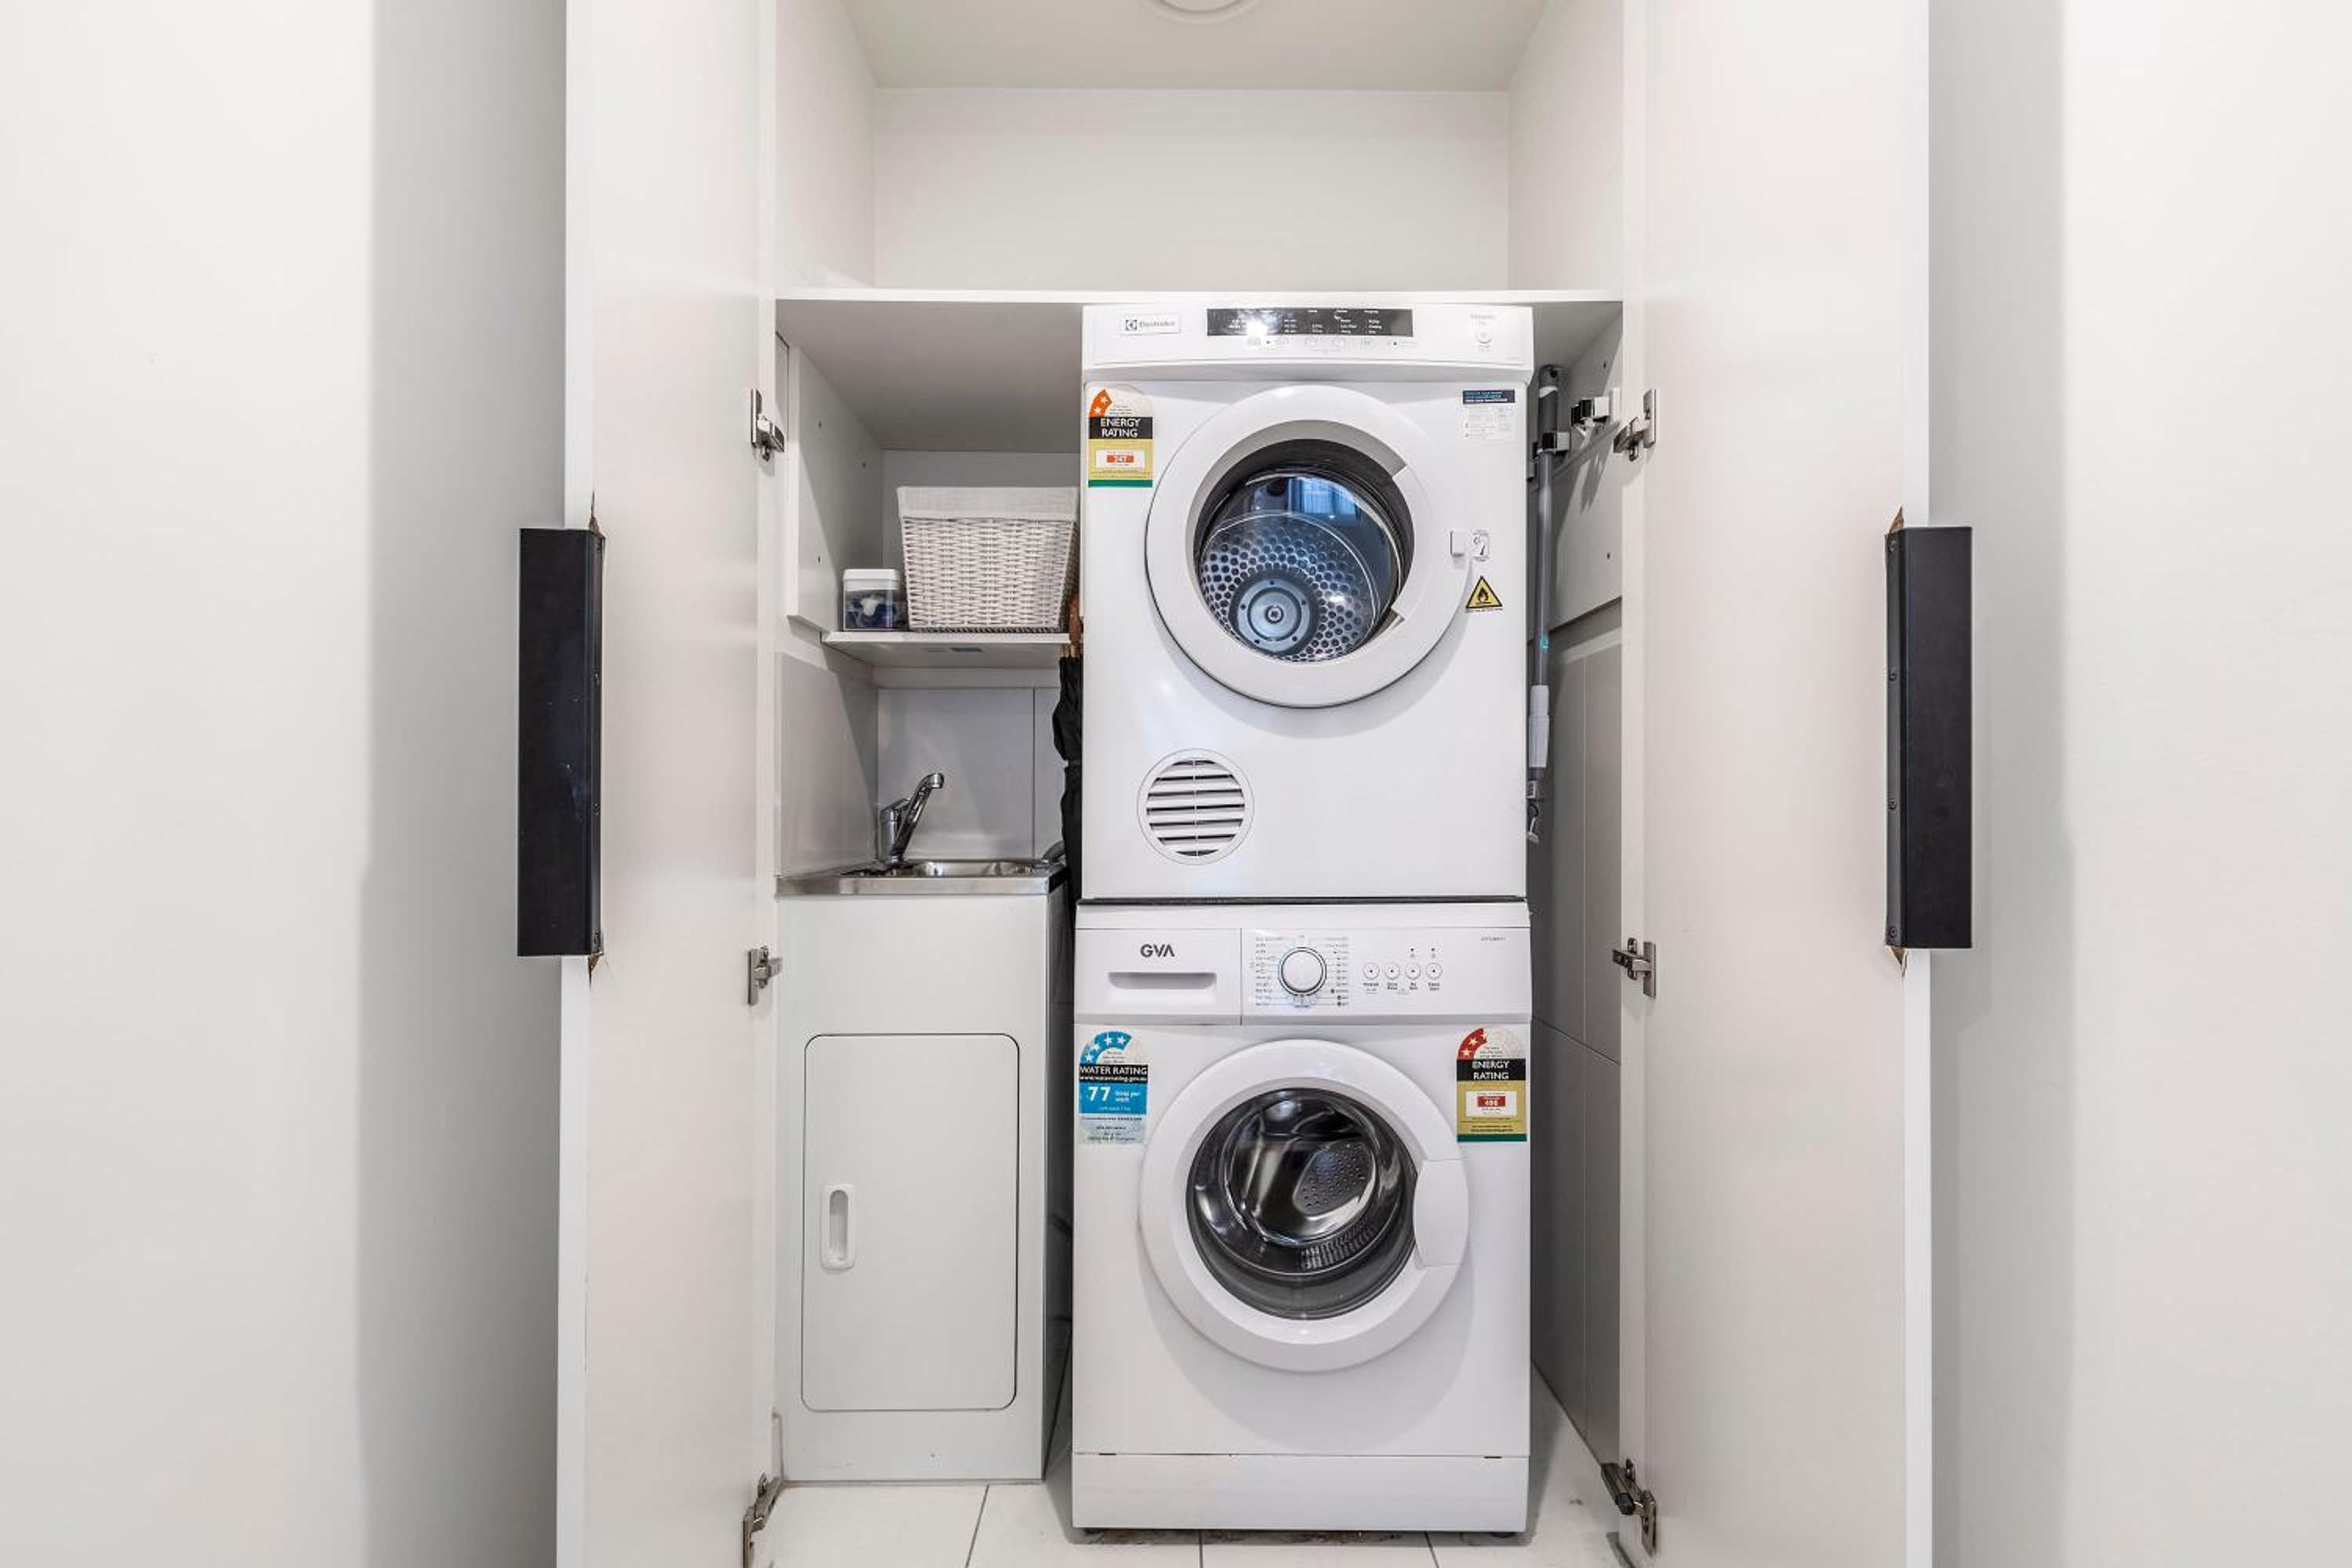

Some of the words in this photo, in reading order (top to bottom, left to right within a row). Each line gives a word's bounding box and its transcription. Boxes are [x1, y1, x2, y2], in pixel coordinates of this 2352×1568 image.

[1100, 418, 1141, 427] ENERGY
[1102, 429, 1138, 437] RATING
[1140, 943, 1175, 958] GVA
[1088, 1086, 1111, 1102] 77
